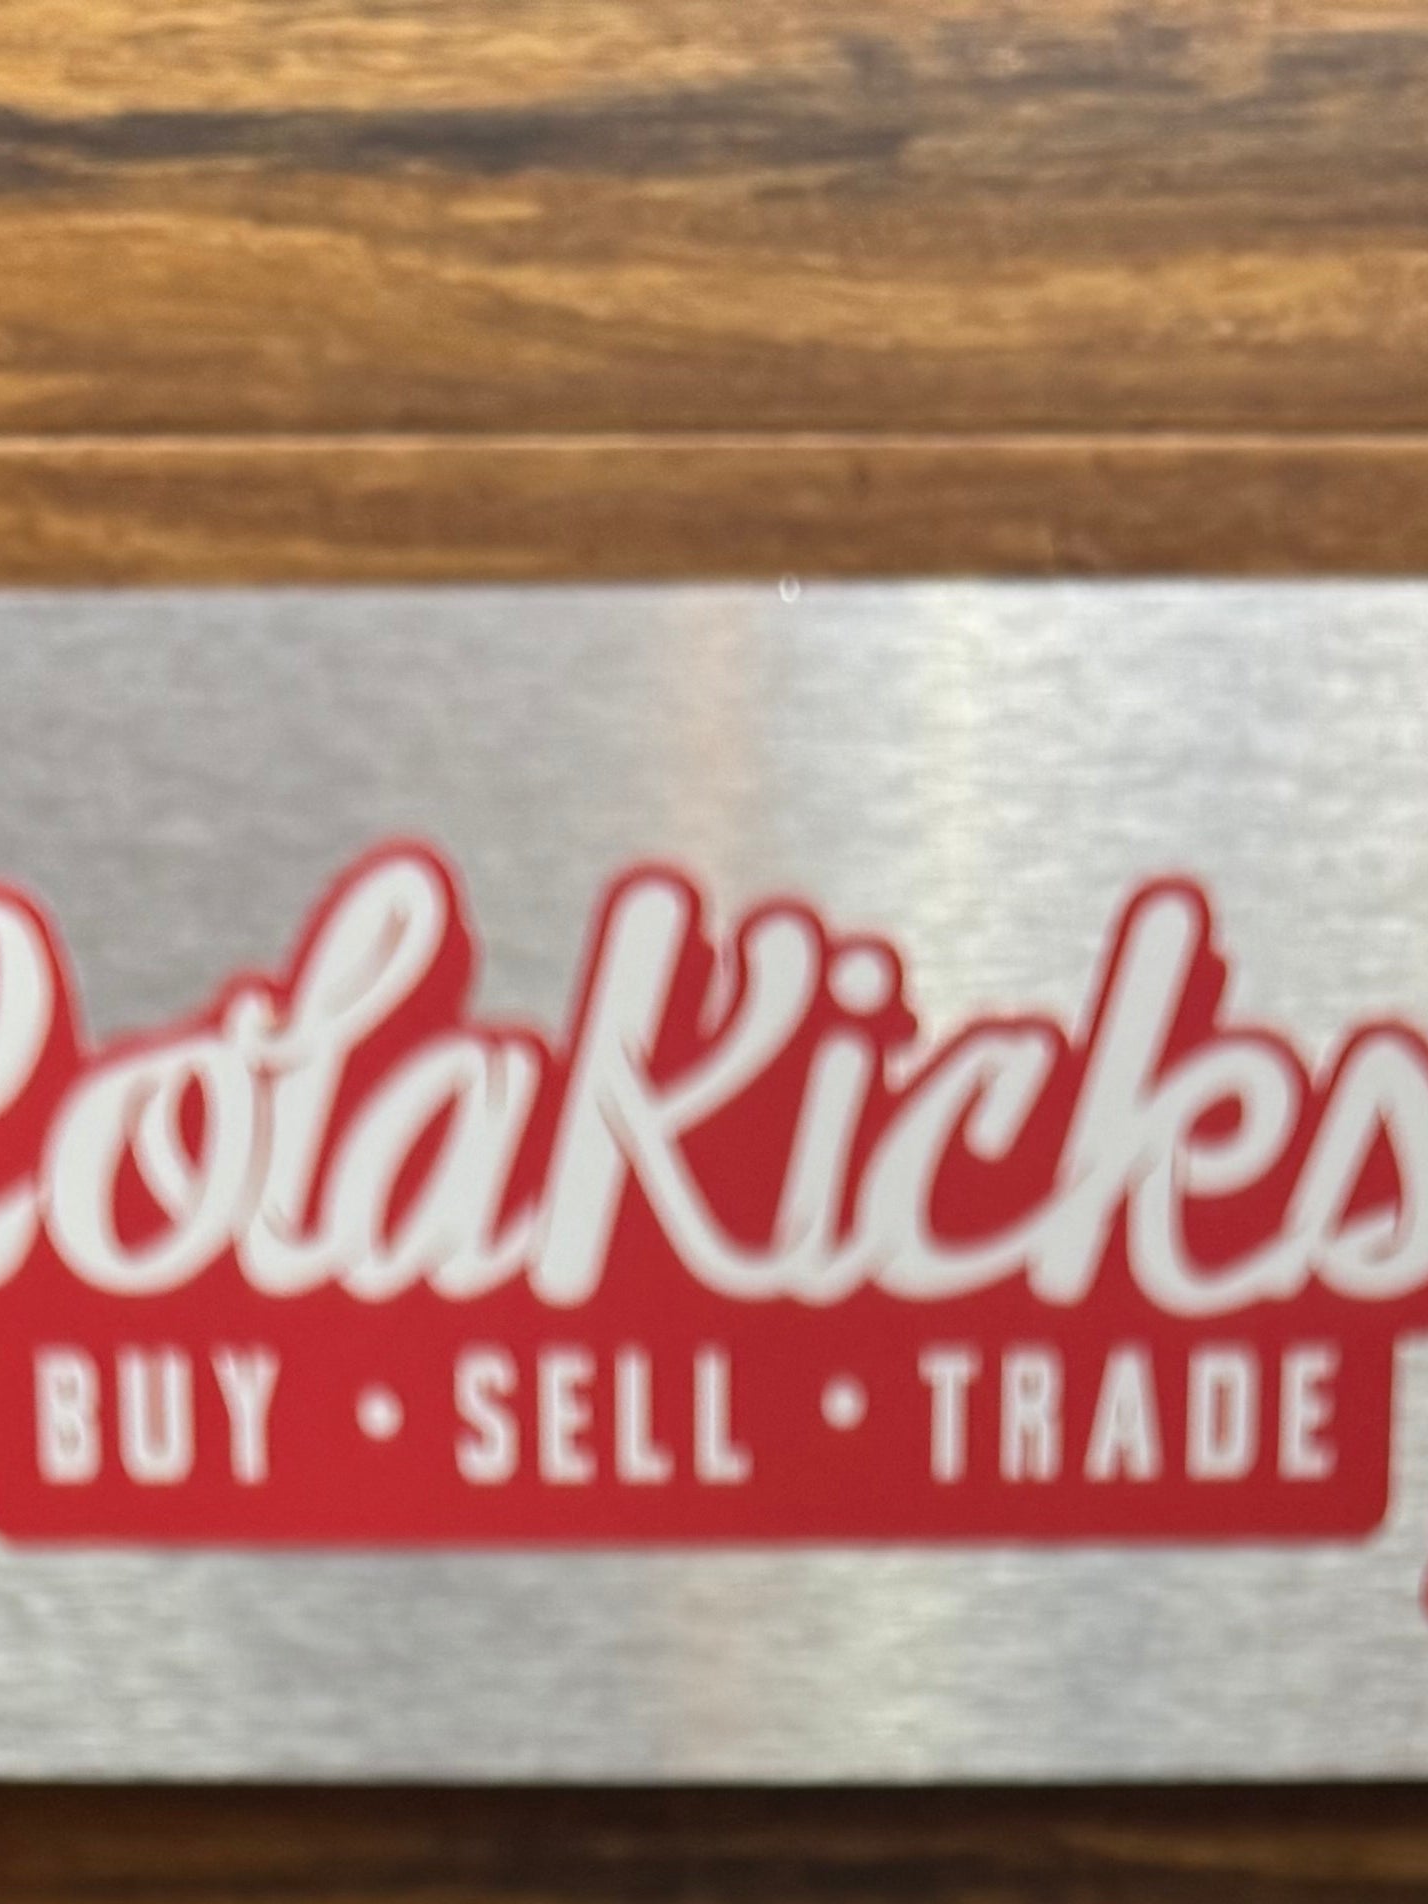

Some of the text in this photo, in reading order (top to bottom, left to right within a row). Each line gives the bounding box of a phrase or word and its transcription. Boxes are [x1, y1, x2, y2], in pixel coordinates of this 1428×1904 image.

[32, 1343, 1340, 1487] BUY SELL TRADE
